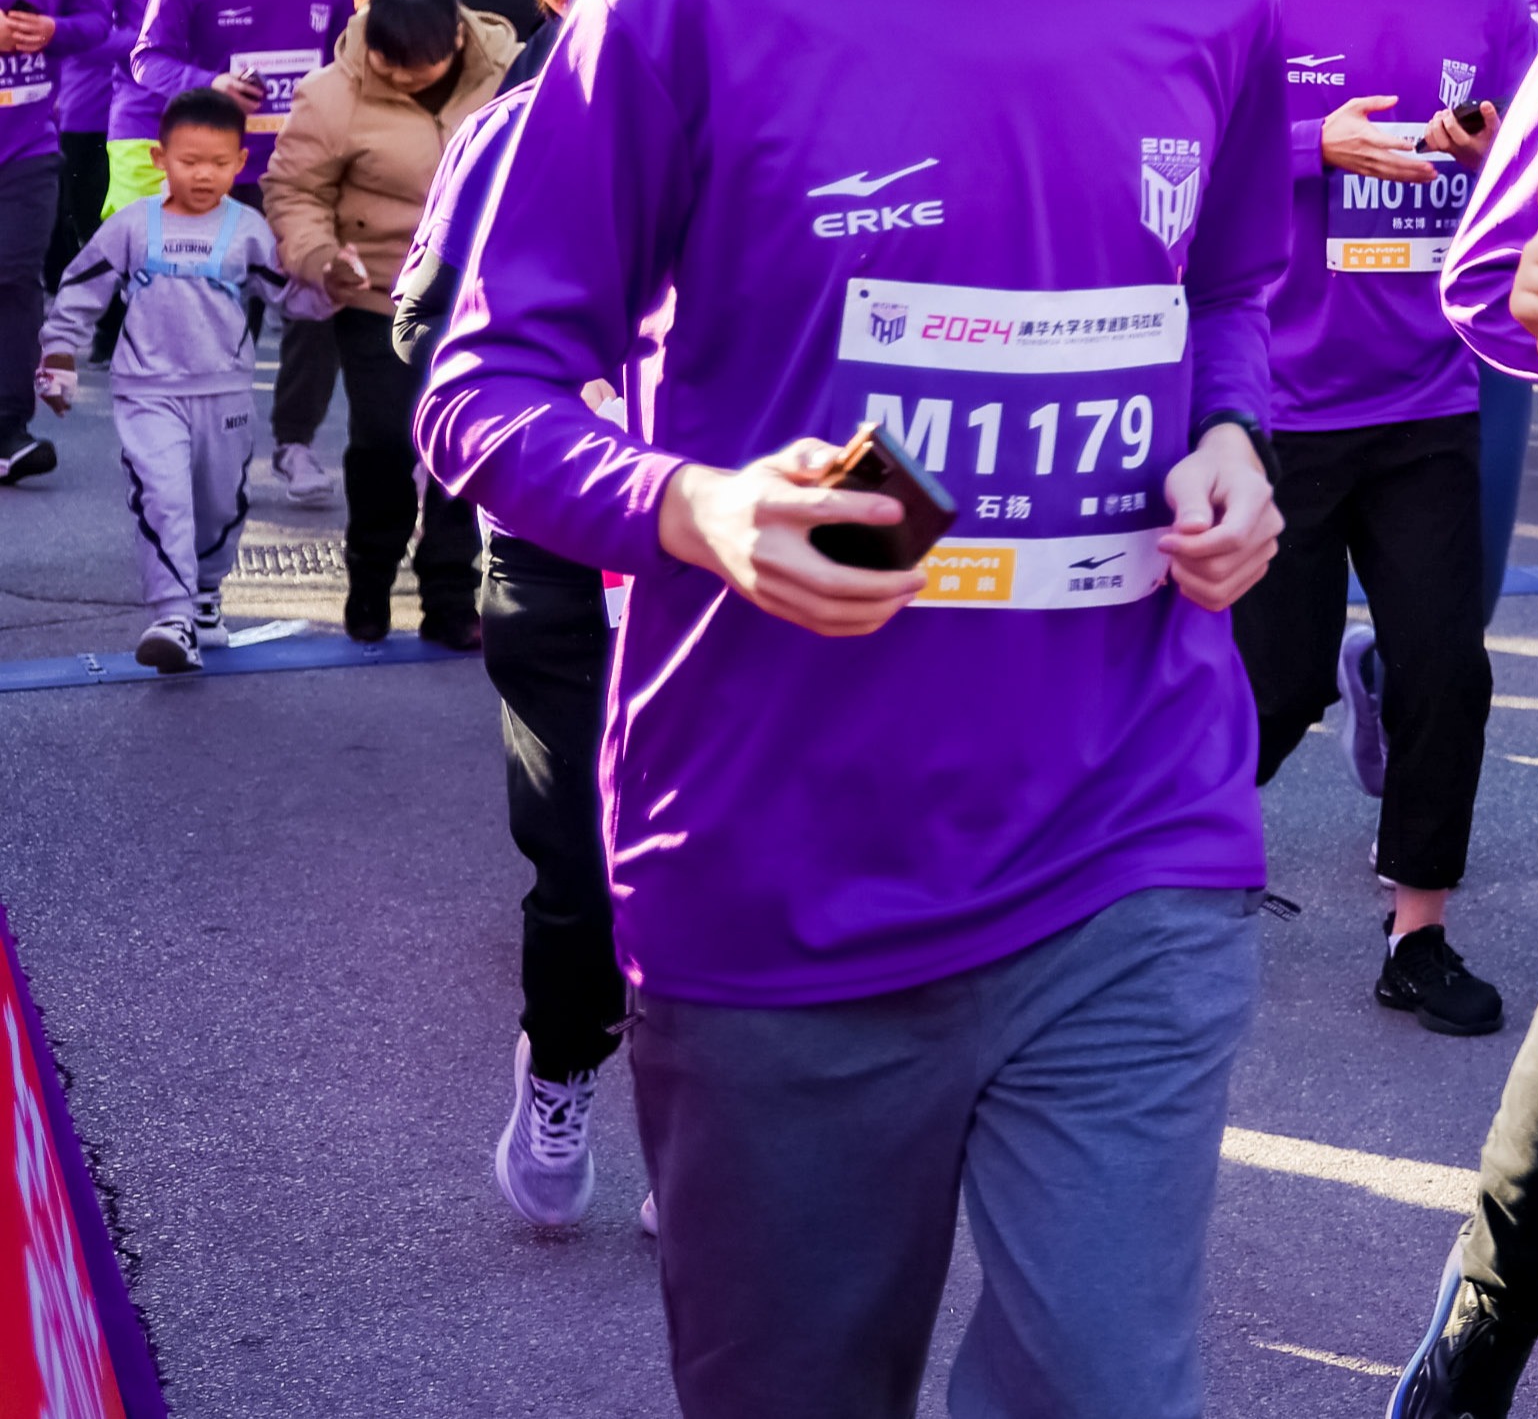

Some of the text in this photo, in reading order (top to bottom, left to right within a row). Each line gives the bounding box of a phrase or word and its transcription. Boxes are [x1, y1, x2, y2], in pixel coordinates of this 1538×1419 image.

[1287, 70, 1346, 86] ERKE
[1141, 137, 1200, 157] 2024
[812, 200, 945, 238] ERKE
[921, 313, 1013, 346] 2024
[866, 392, 1154, 476] M1179
[975, 494, 1033, 520] 石扬
[921, 555, 1000, 569] MMI
